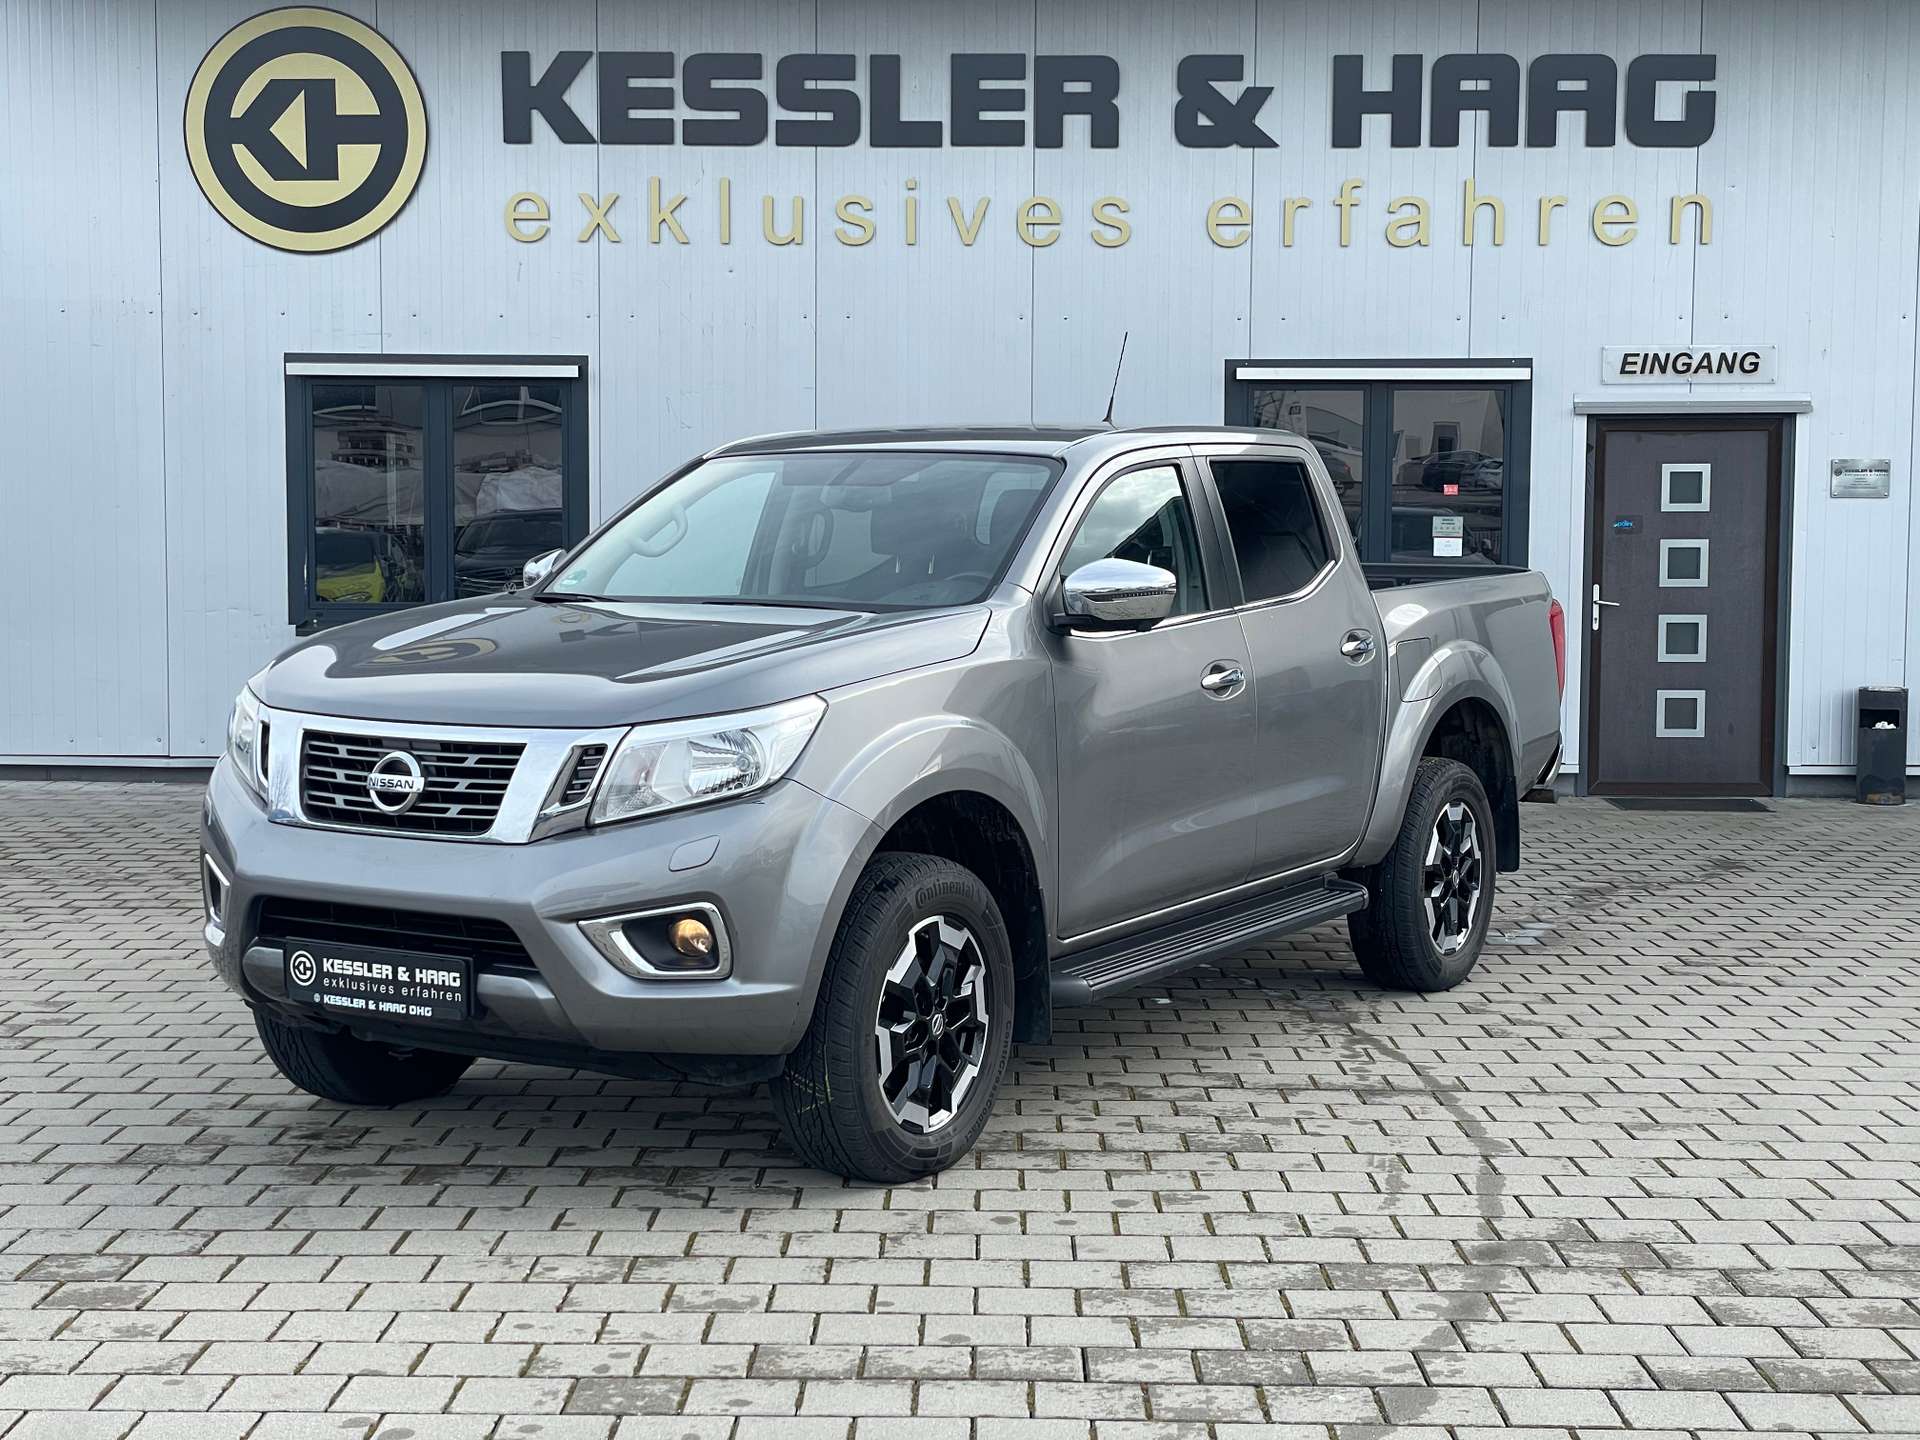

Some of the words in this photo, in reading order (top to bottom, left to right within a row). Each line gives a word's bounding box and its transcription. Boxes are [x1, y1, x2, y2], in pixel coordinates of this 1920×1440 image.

[502, 50, 1120, 148] KESSLER
[1174, 54, 1280, 148] &
[1331, 53, 1717, 148] HAAG
[503, 177, 1132, 248] exklusives
[1206, 179, 1713, 247] erfahren
[1619, 351, 1761, 375] EINGANG
[368, 777, 415, 789] NISSAN
[915, 879, 975, 909] Continental
[322, 957, 393, 980] KESSLER
[397, 966, 410, 982] &
[415, 968, 461, 987] HAAG
[323, 976, 395, 994] exklusives
[401, 986, 462, 1002] erfahren
[323, 994, 366, 1009] KESSLER
[368, 1001, 376, 1010] &
[379, 1002, 407, 1014] HAAG
[409, 1006, 432, 1017] OHG
